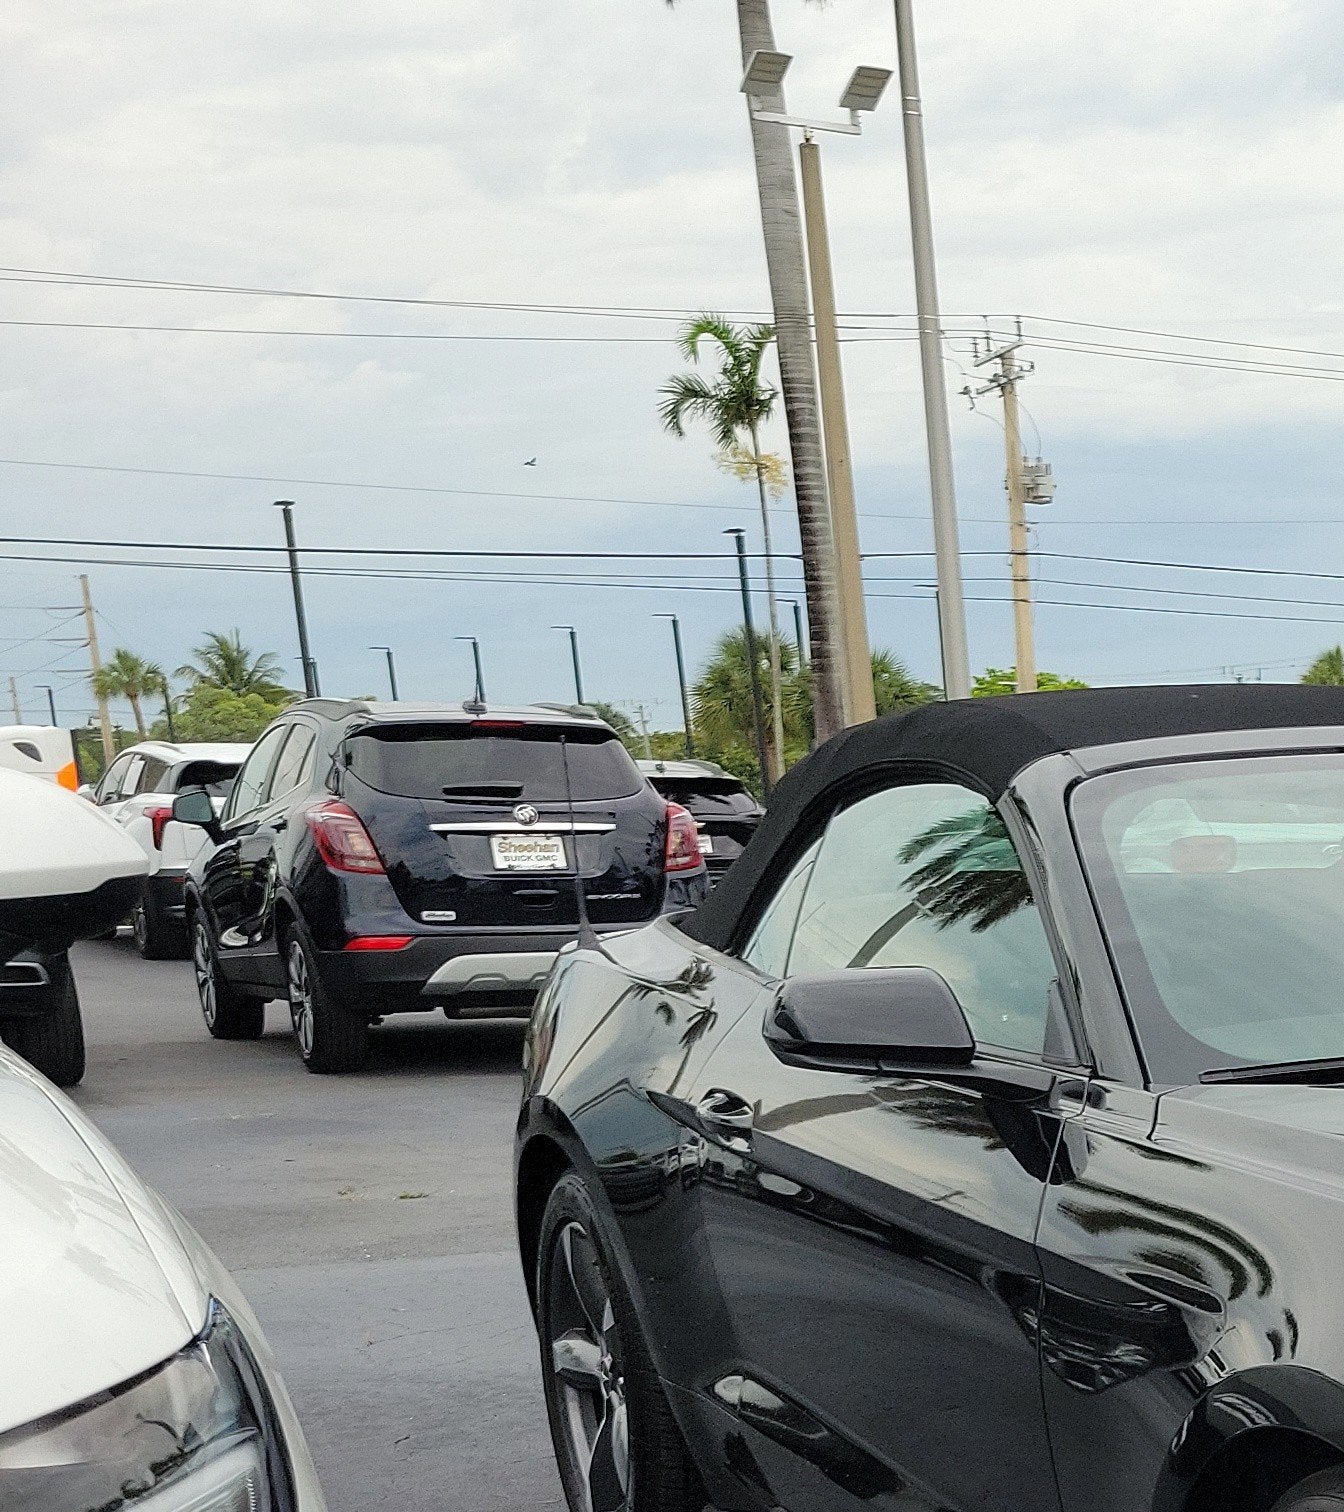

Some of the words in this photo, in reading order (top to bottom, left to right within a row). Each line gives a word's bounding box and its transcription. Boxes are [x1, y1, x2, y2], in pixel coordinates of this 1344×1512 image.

[498, 841, 559, 853] Sheehan
[503, 854, 534, 862] BUICK
[536, 854, 558, 862] GMC
